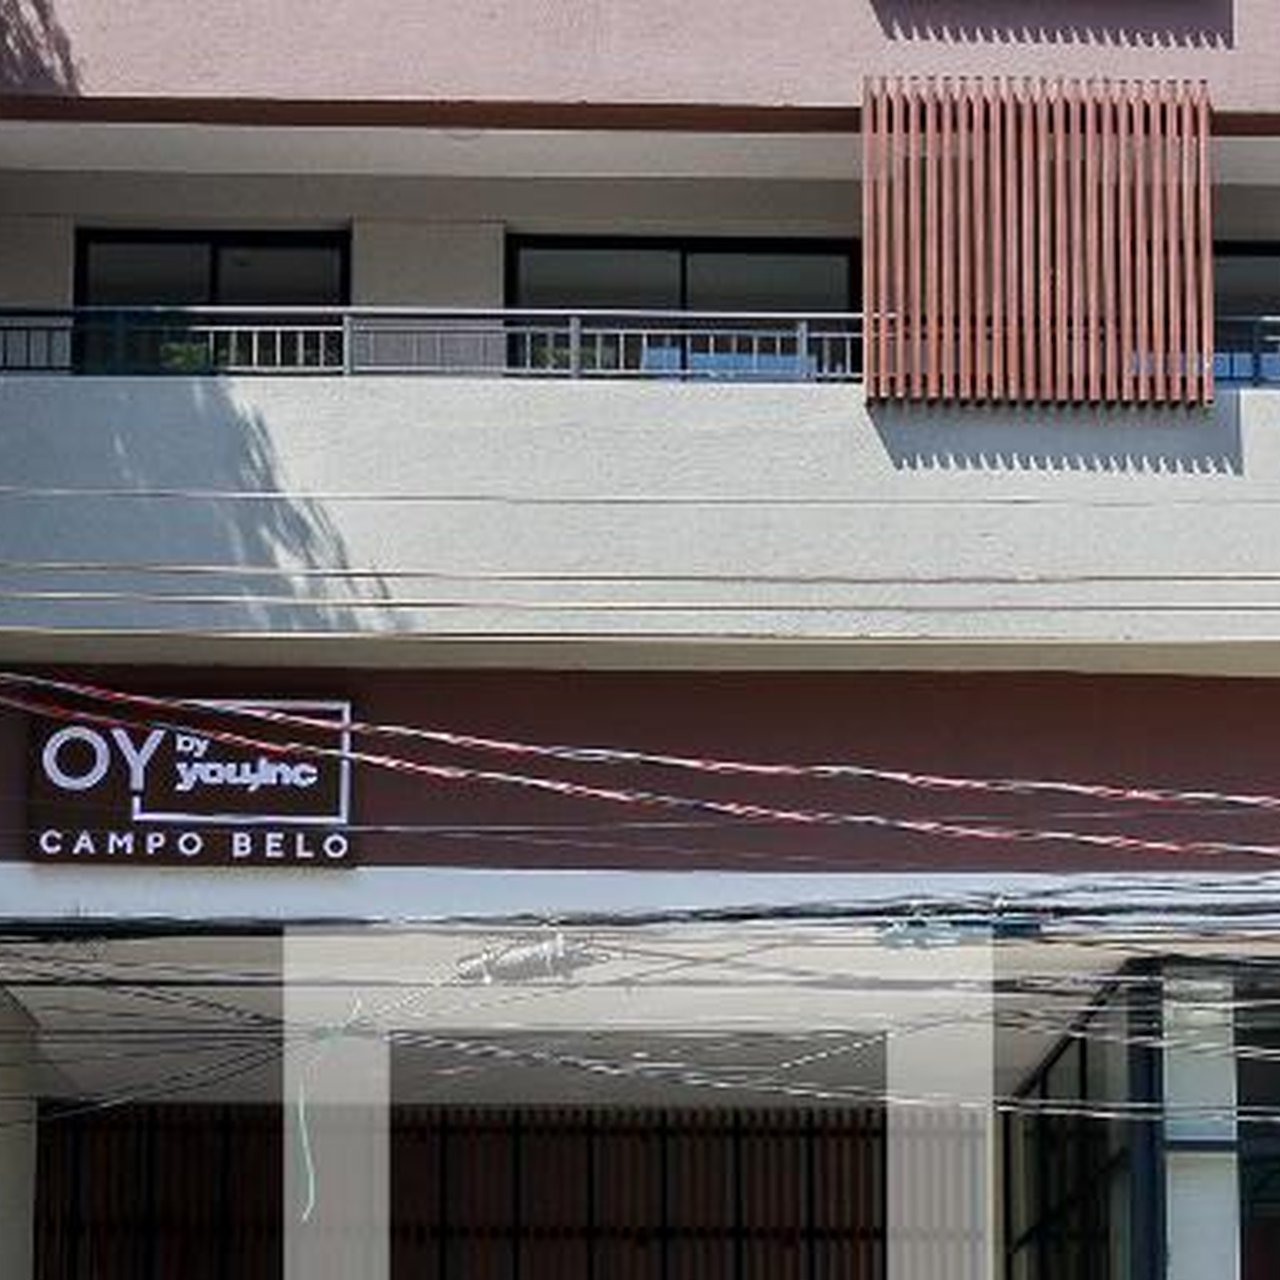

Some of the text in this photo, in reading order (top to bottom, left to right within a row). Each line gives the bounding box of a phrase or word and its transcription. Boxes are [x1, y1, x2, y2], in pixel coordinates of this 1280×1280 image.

[41, 726, 166, 791] OY
[176, 734, 210, 757] by
[39, 831, 349, 858] CAMPO BELO
